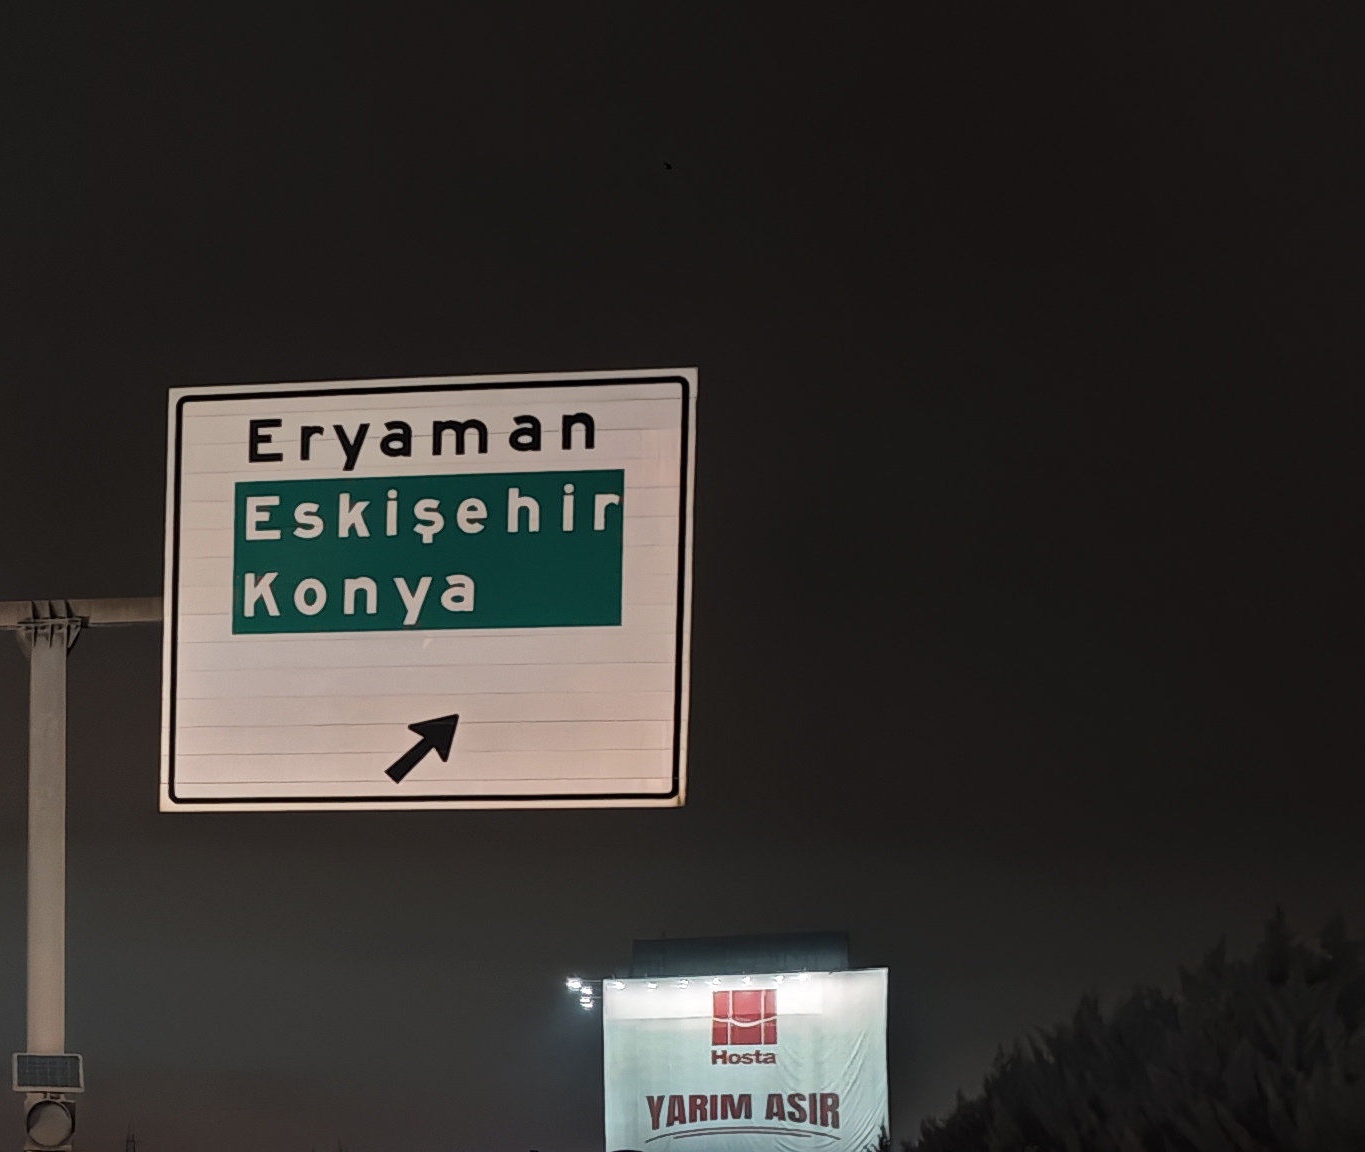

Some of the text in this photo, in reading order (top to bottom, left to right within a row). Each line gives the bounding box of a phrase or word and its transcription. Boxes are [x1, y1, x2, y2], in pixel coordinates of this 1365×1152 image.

[248, 412, 595, 472] Eryaman
[245, 483, 621, 544] Eskişehir
[243, 571, 477, 626] Konya
[711, 1050, 777, 1065] Hosta
[645, 1092, 840, 1130] YARIM ASIR
